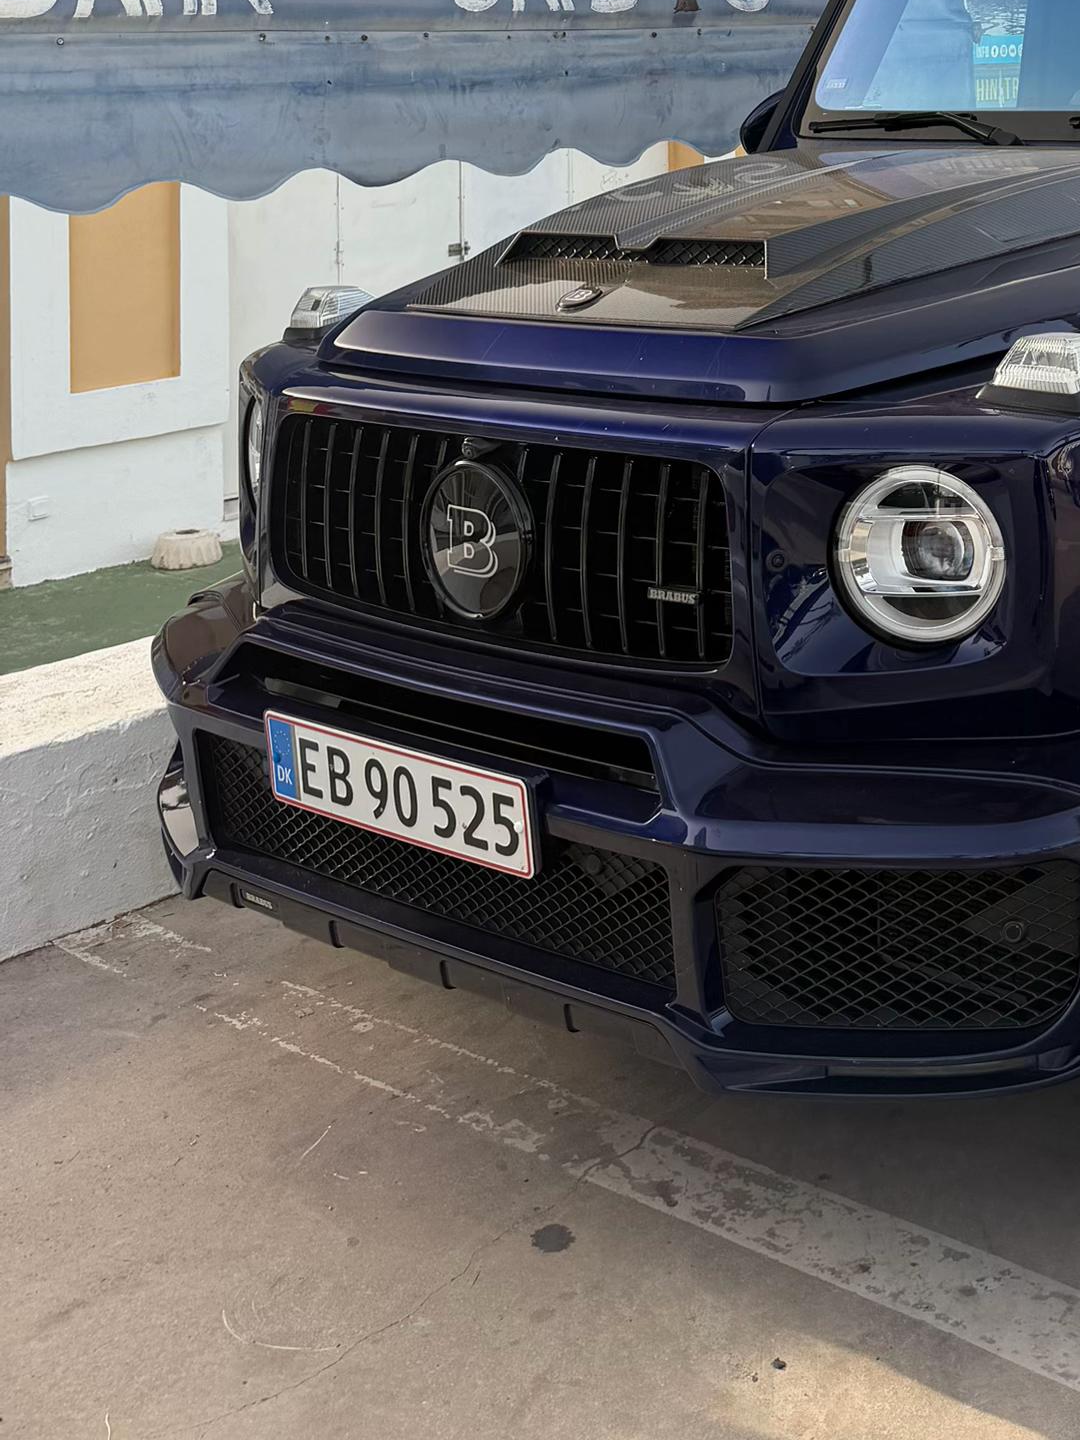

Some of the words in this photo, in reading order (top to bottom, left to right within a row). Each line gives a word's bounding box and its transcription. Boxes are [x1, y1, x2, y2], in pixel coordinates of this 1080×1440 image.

[446, 503, 498, 579] B
[648, 588, 697, 605] BRABUS
[277, 763, 293, 786] DK
[297, 737, 354, 807] EB
[364, 758, 419, 829] 90
[433, 776, 522, 858] 525
